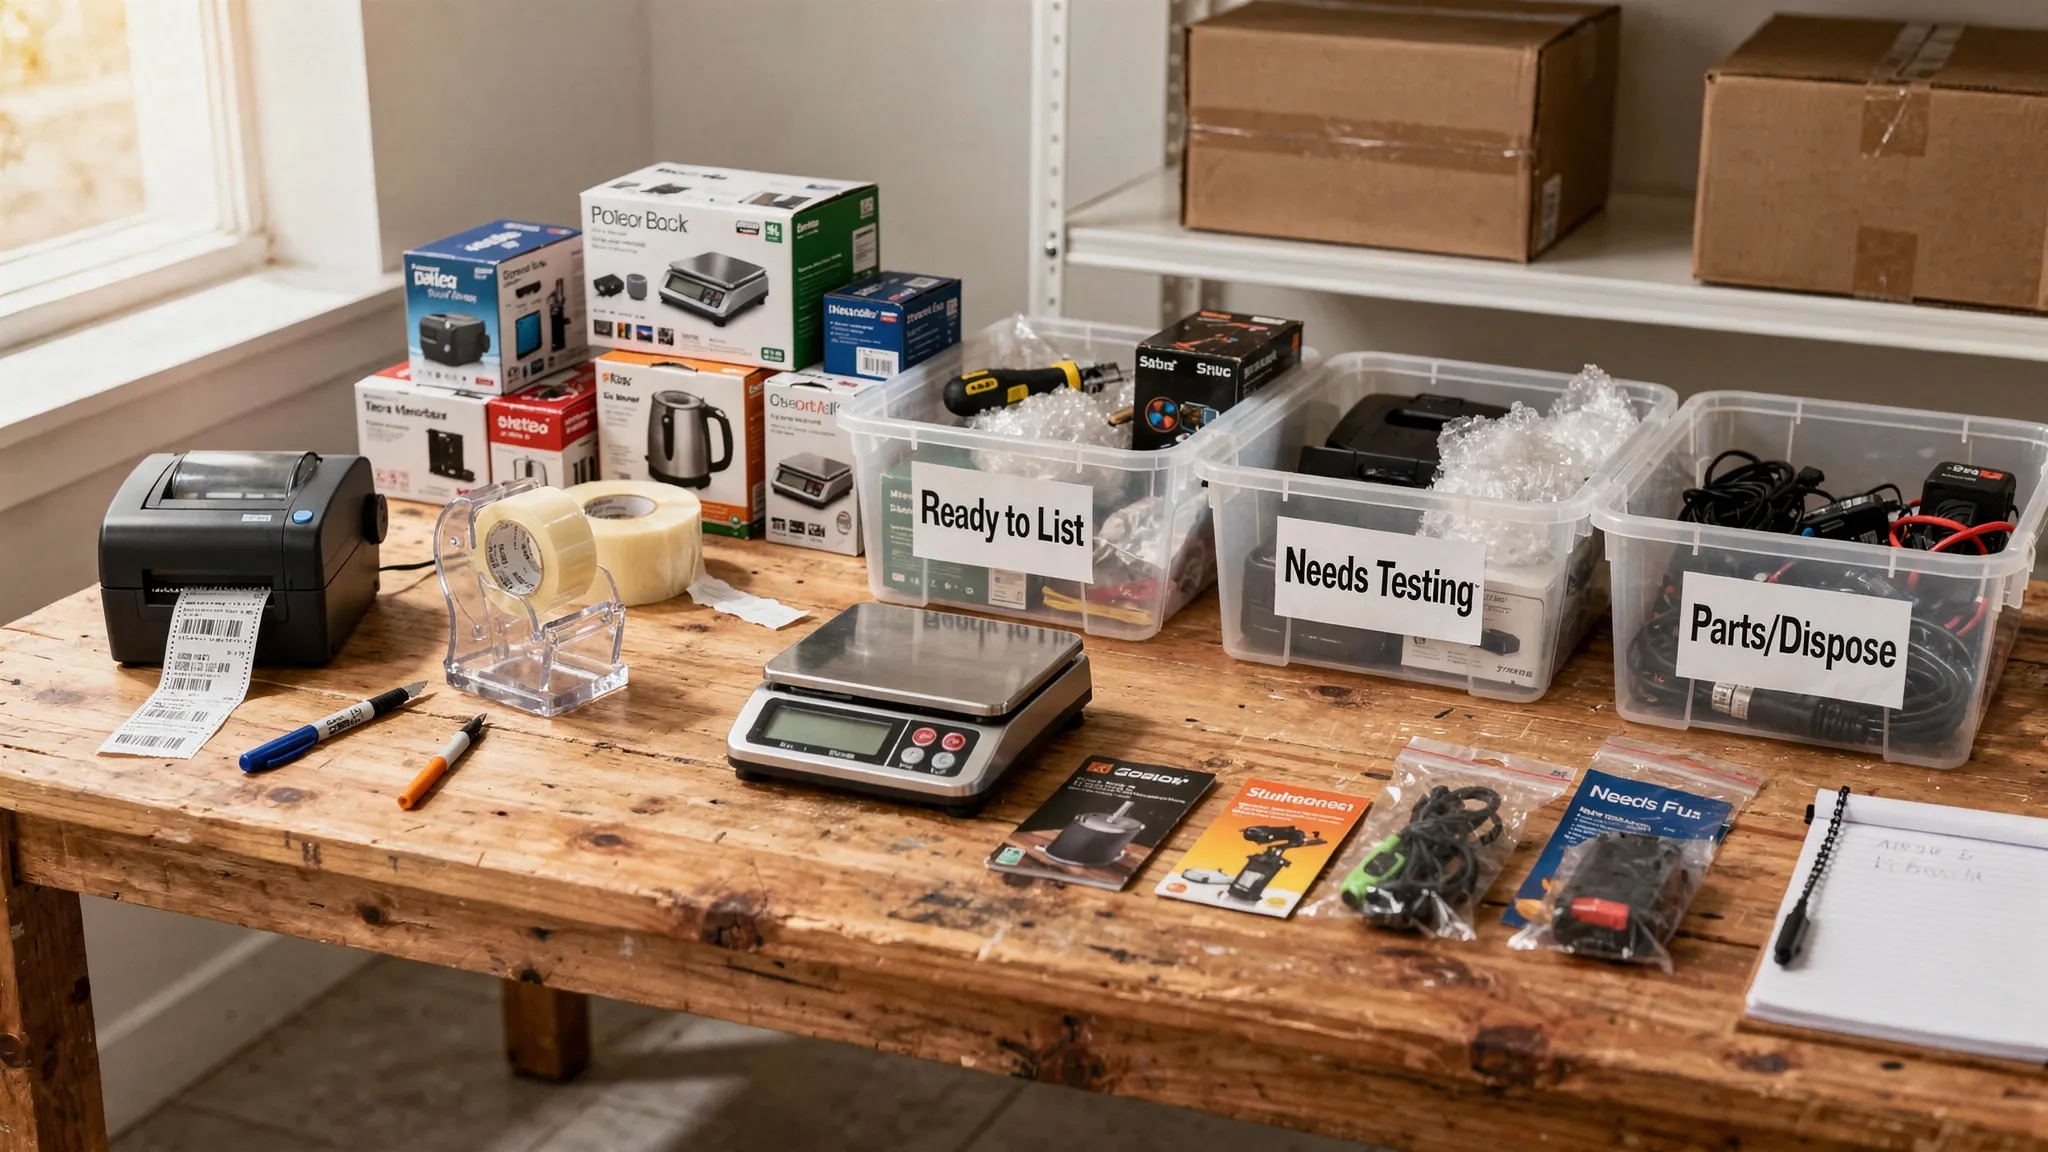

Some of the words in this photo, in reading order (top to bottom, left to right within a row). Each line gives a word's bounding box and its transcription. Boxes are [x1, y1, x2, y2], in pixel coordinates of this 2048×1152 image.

[646, 211, 689, 233] Back
[920, 489, 999, 544] Ready
[1005, 505, 1031, 538] to
[1037, 506, 1085, 547] List
[1285, 546, 1369, 594] Needs
[1376, 559, 1474, 617] Testing
[1690, 602, 1897, 670] Parts/Dispose
[1589, 784, 1659, 811] Needs
